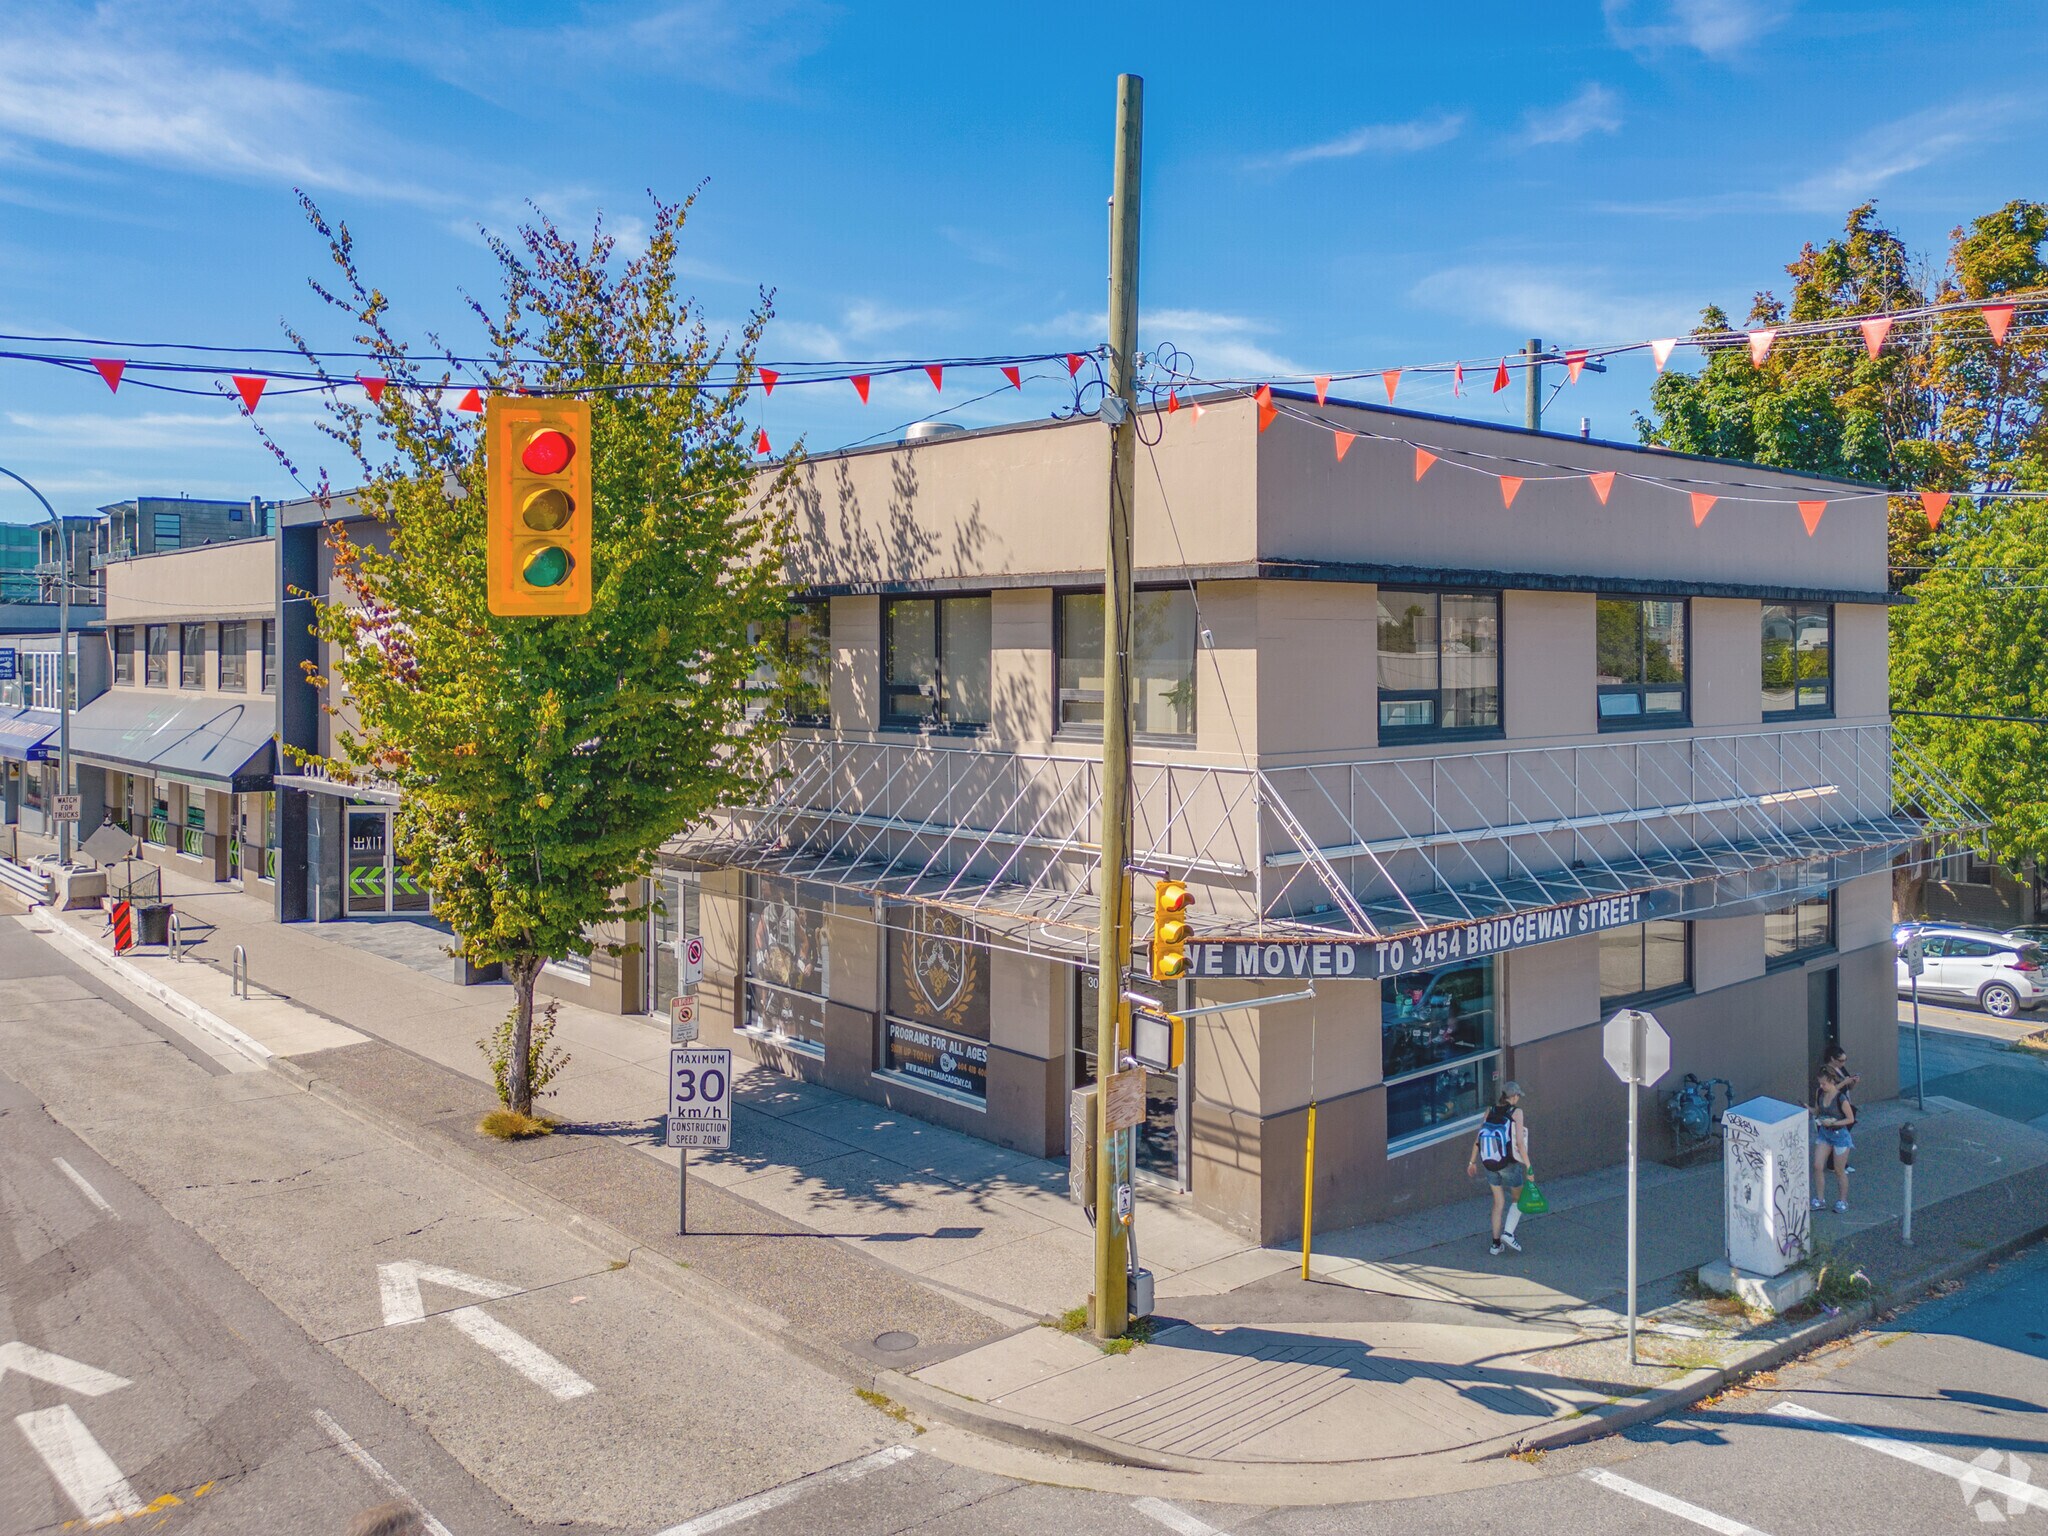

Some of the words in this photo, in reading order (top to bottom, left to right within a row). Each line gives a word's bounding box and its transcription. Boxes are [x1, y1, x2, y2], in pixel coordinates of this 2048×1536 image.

[57, 796, 78, 804] WATCH
[54, 811, 79, 819] TRUCKS
[1235, 944, 1356, 976] MOVED
[1376, 942, 1404, 973] TO
[1411, 926, 1461, 966] 3454
[1466, 908, 1574, 955] BRIDGEWAY
[1578, 894, 1641, 932] STREET
[890, 1025, 930, 1047] PROGRAMS
[931, 1036, 947, 1051] FOR
[948, 1041, 964, 1056] ALL
[966, 1045, 988, 1063] AGES
[676, 1054, 725, 1064] MAXIMUM
[675, 1069, 725, 1102] 30
[678, 1106, 722, 1118] km/h
[671, 1122, 727, 1132] CONSTRUCTION
[676, 1135, 698, 1144] SPEED
[702, 1135, 721, 1145] ZONE
